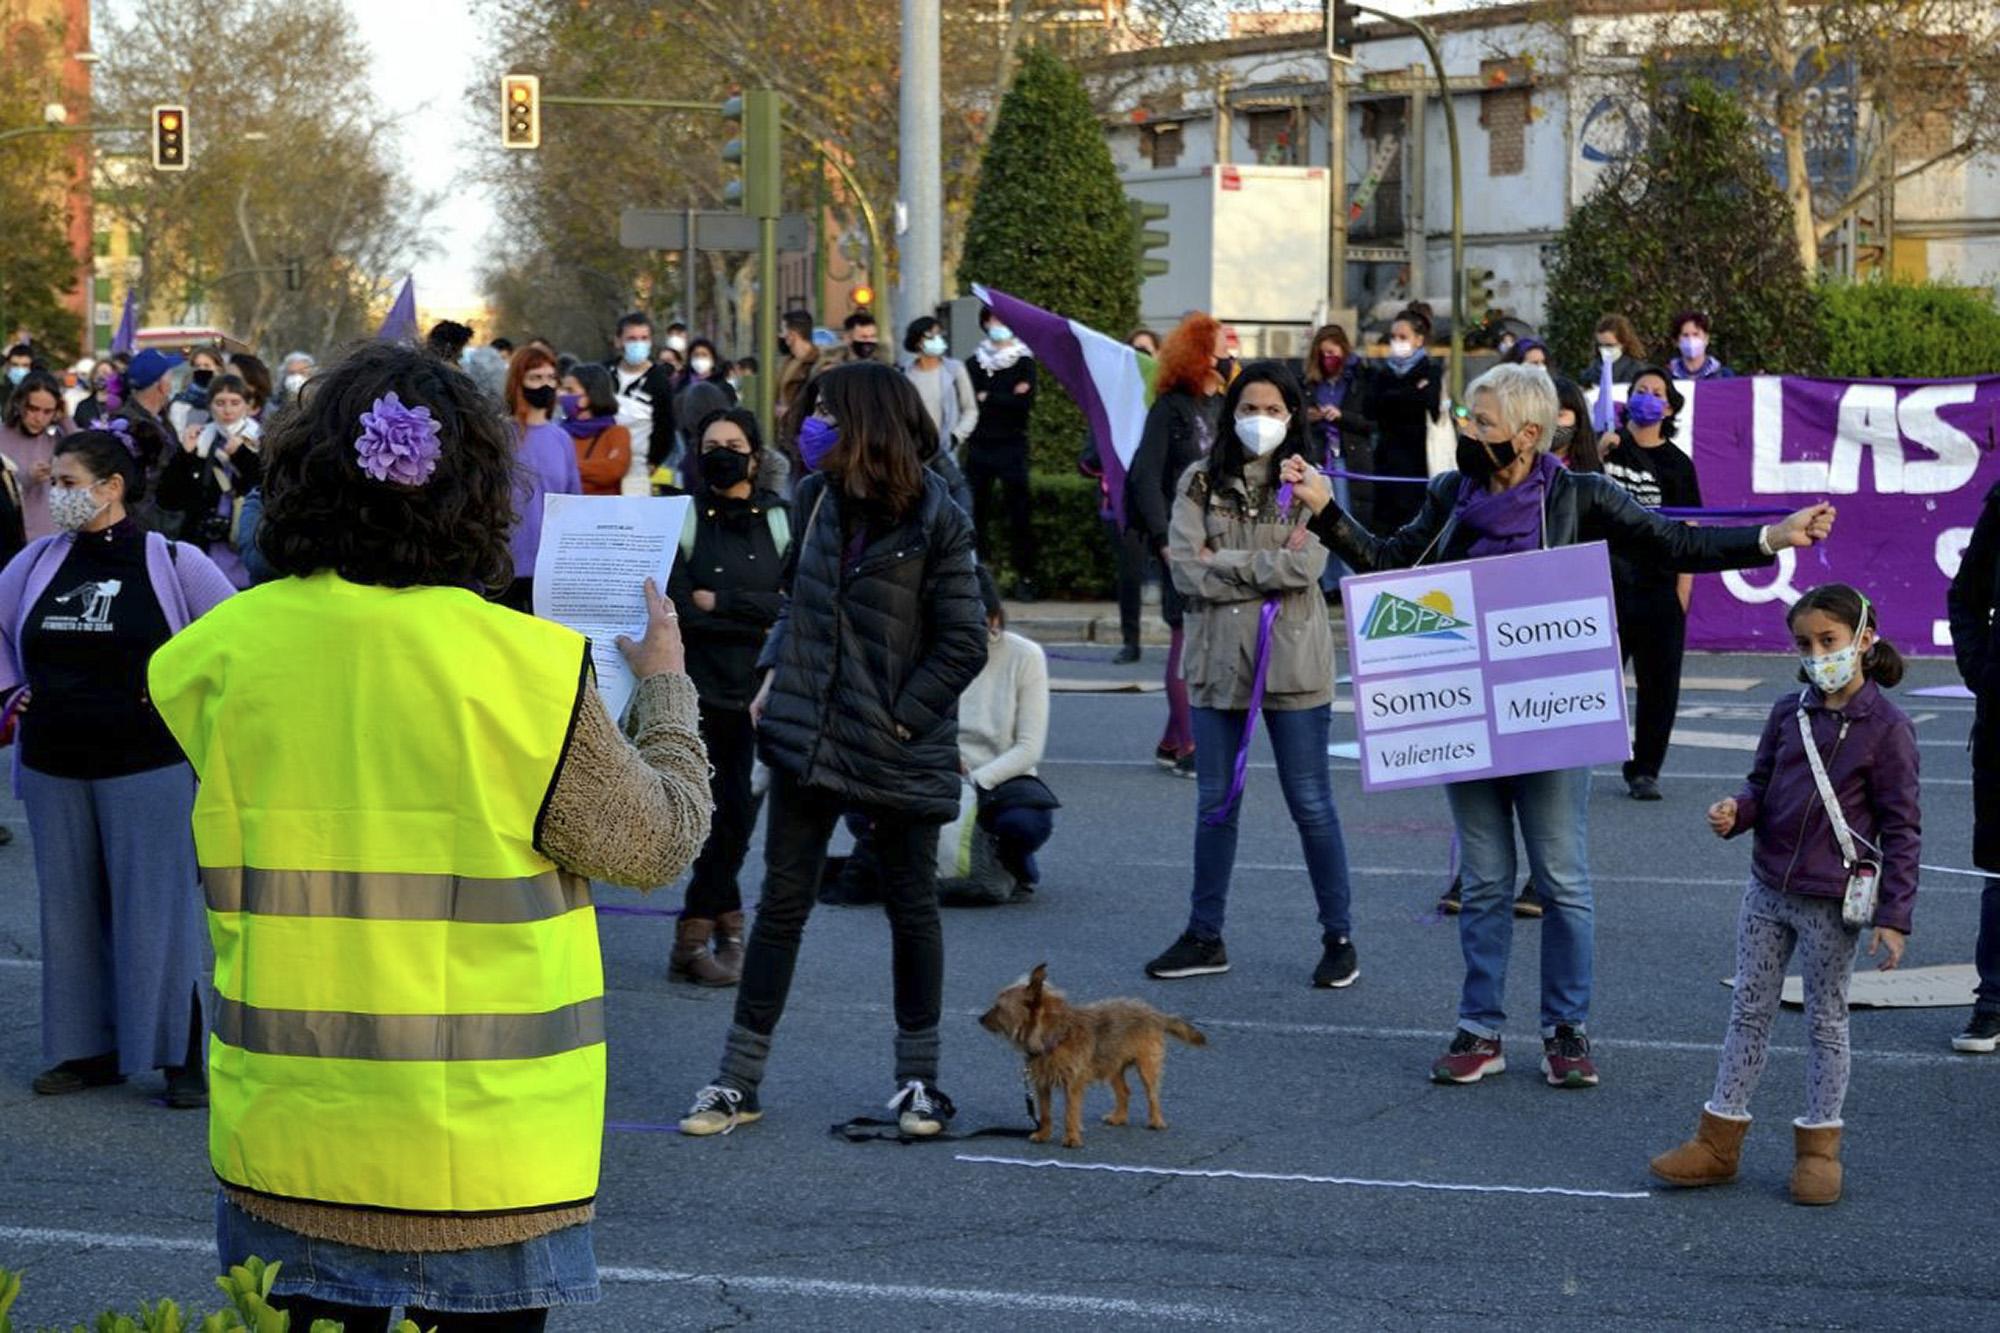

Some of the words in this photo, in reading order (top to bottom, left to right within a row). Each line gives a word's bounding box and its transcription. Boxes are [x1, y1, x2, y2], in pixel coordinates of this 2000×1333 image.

[1752, 376, 1980, 494] LAS
[1497, 616, 1597, 648] Somos
[1372, 686, 1472, 718] Somos
[1508, 691, 1606, 723] Mujeres
[1381, 741, 1476, 769] Valientes
